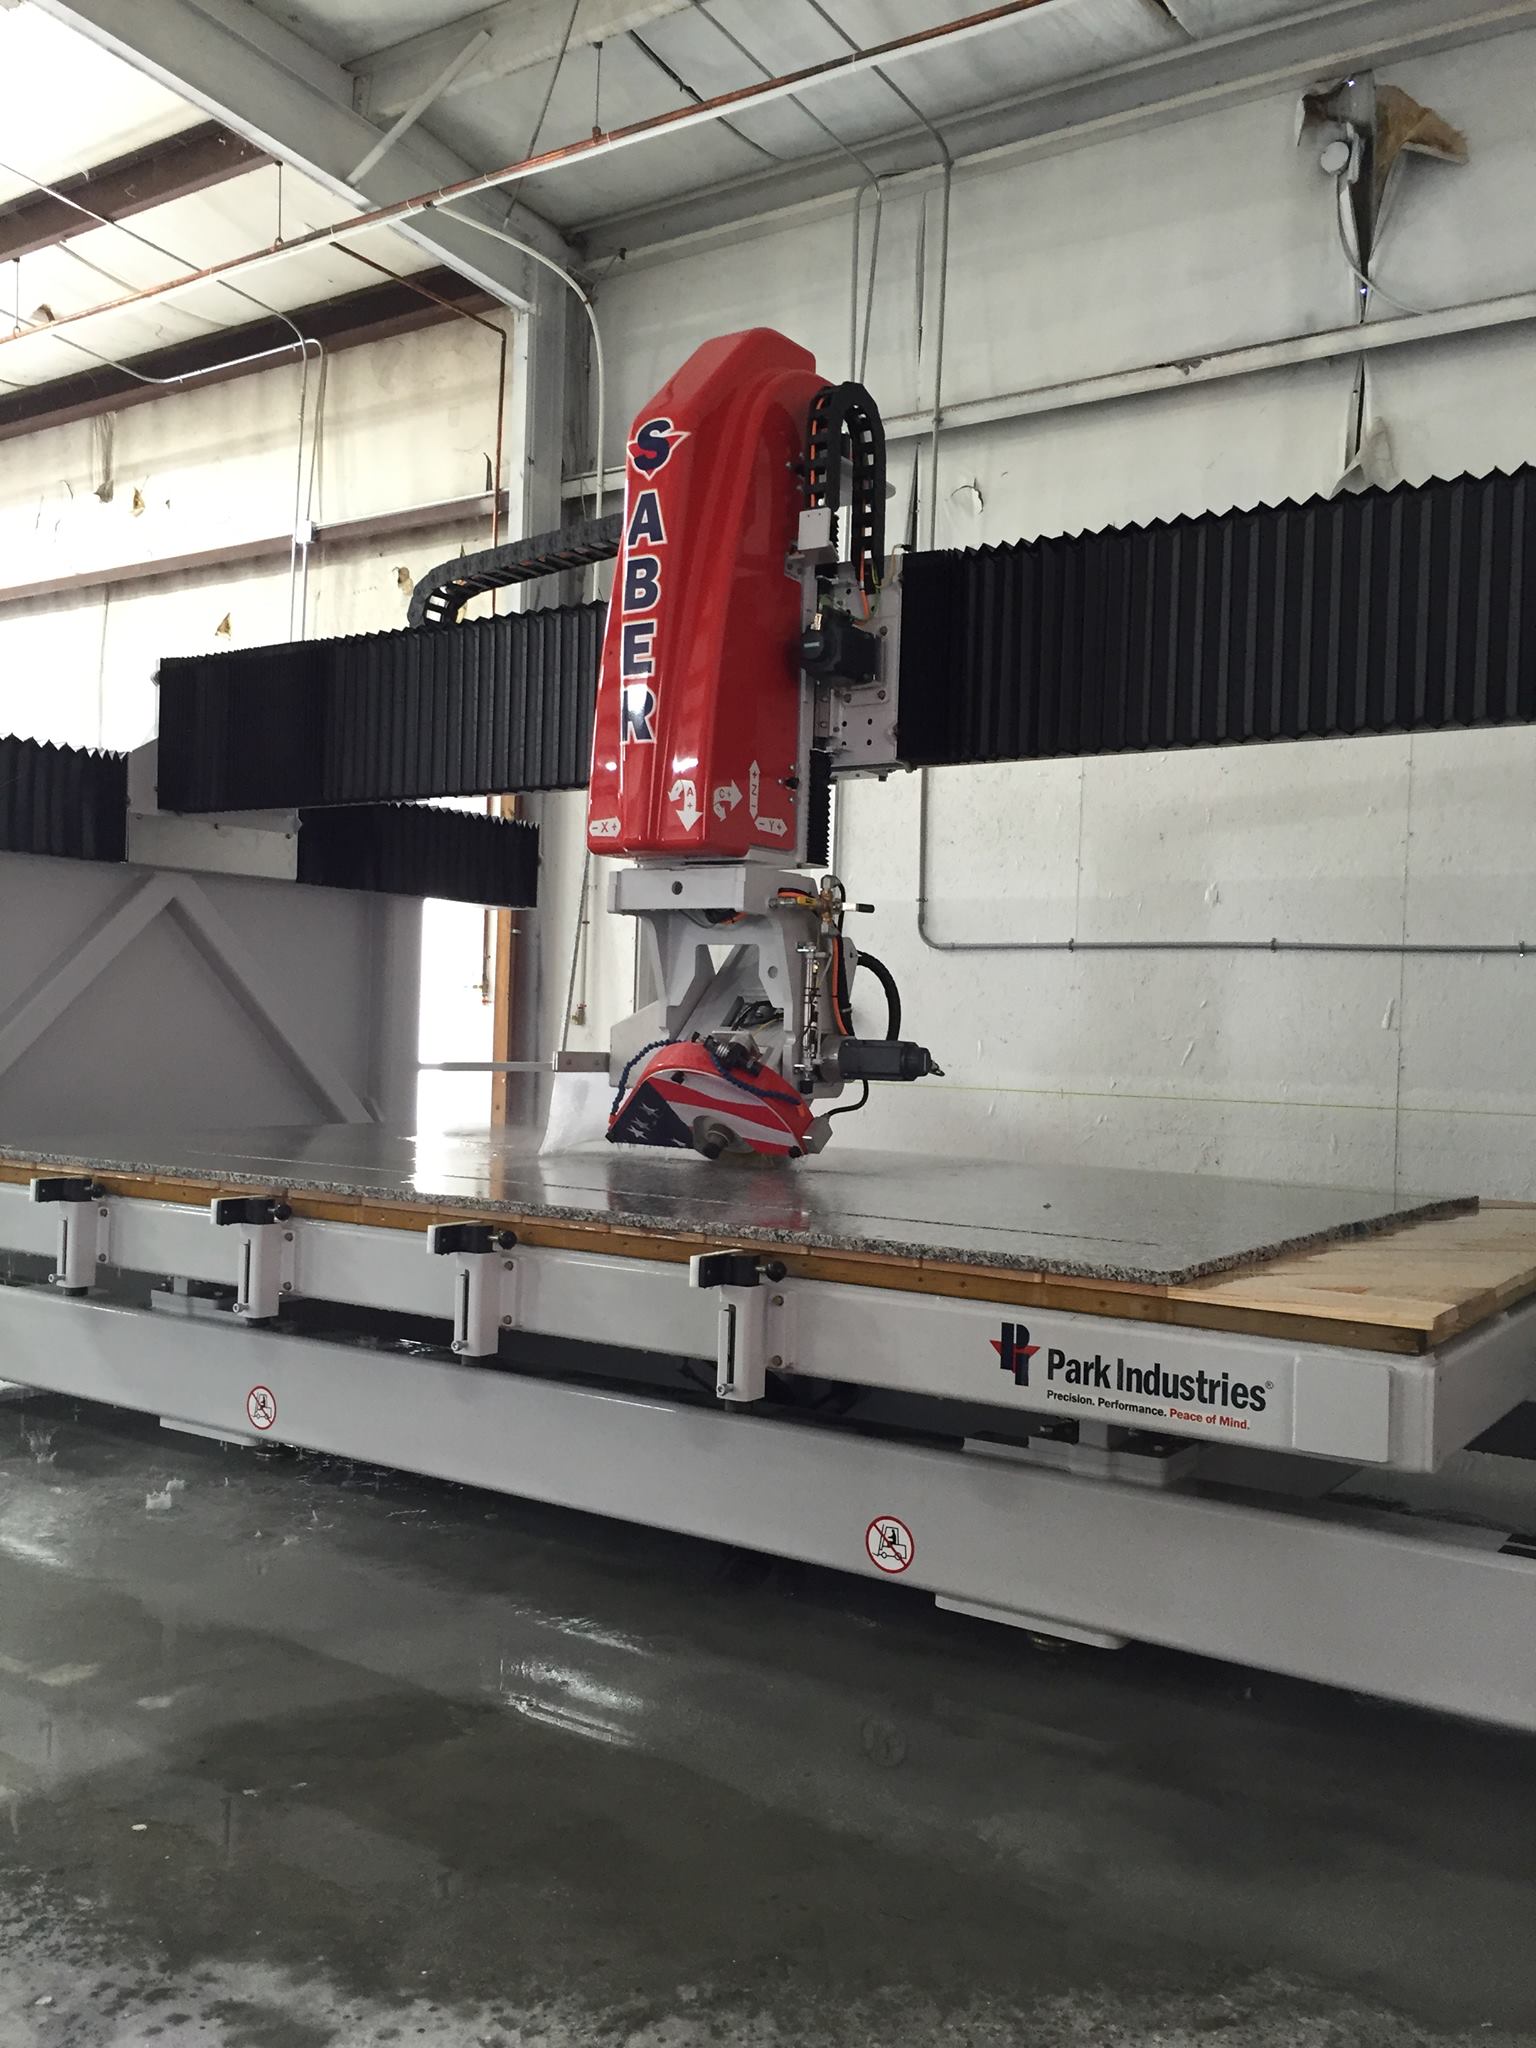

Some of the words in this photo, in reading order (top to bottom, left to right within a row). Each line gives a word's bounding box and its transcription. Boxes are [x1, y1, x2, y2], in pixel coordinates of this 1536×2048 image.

[621, 417, 680, 745] SABER
[1047, 1346, 1111, 1391] Park
[1046, 1389, 1096, 1407] Precision.
[1097, 1396, 1168, 1418] Performance.
[1169, 1407, 1203, 1424] Peace
[1204, 1412, 1217, 1425] of
[1218, 1415, 1251, 1431] Mind.
